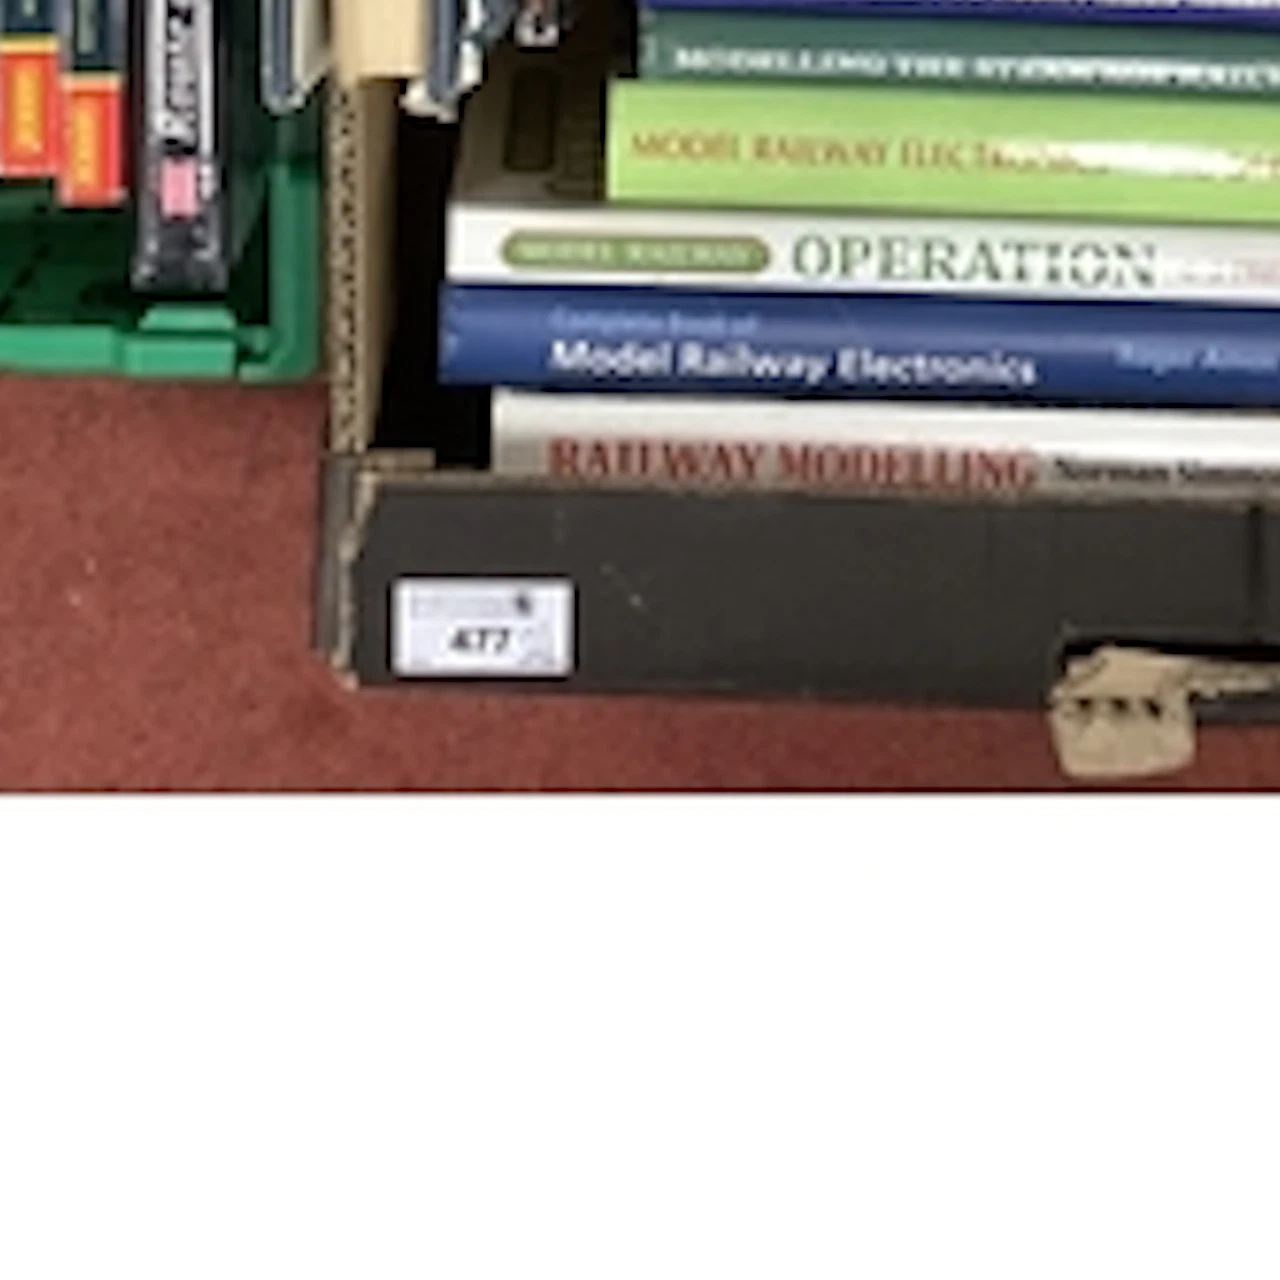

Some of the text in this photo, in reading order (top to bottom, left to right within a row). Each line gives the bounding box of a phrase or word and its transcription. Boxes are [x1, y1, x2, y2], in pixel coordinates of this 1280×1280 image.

[675, 47, 887, 78] MODELLING
[895, 52, 965, 79] THE
[631, 131, 887, 167] MODEL RAILWAY
[790, 235, 1156, 287] OPERATION
[549, 340, 1038, 386] Model Railway Electronics
[547, 438, 1038, 487] RAILWAY MODELLING
[1056, 458, 1169, 484] Norman
[449, 627, 512, 655] 477
